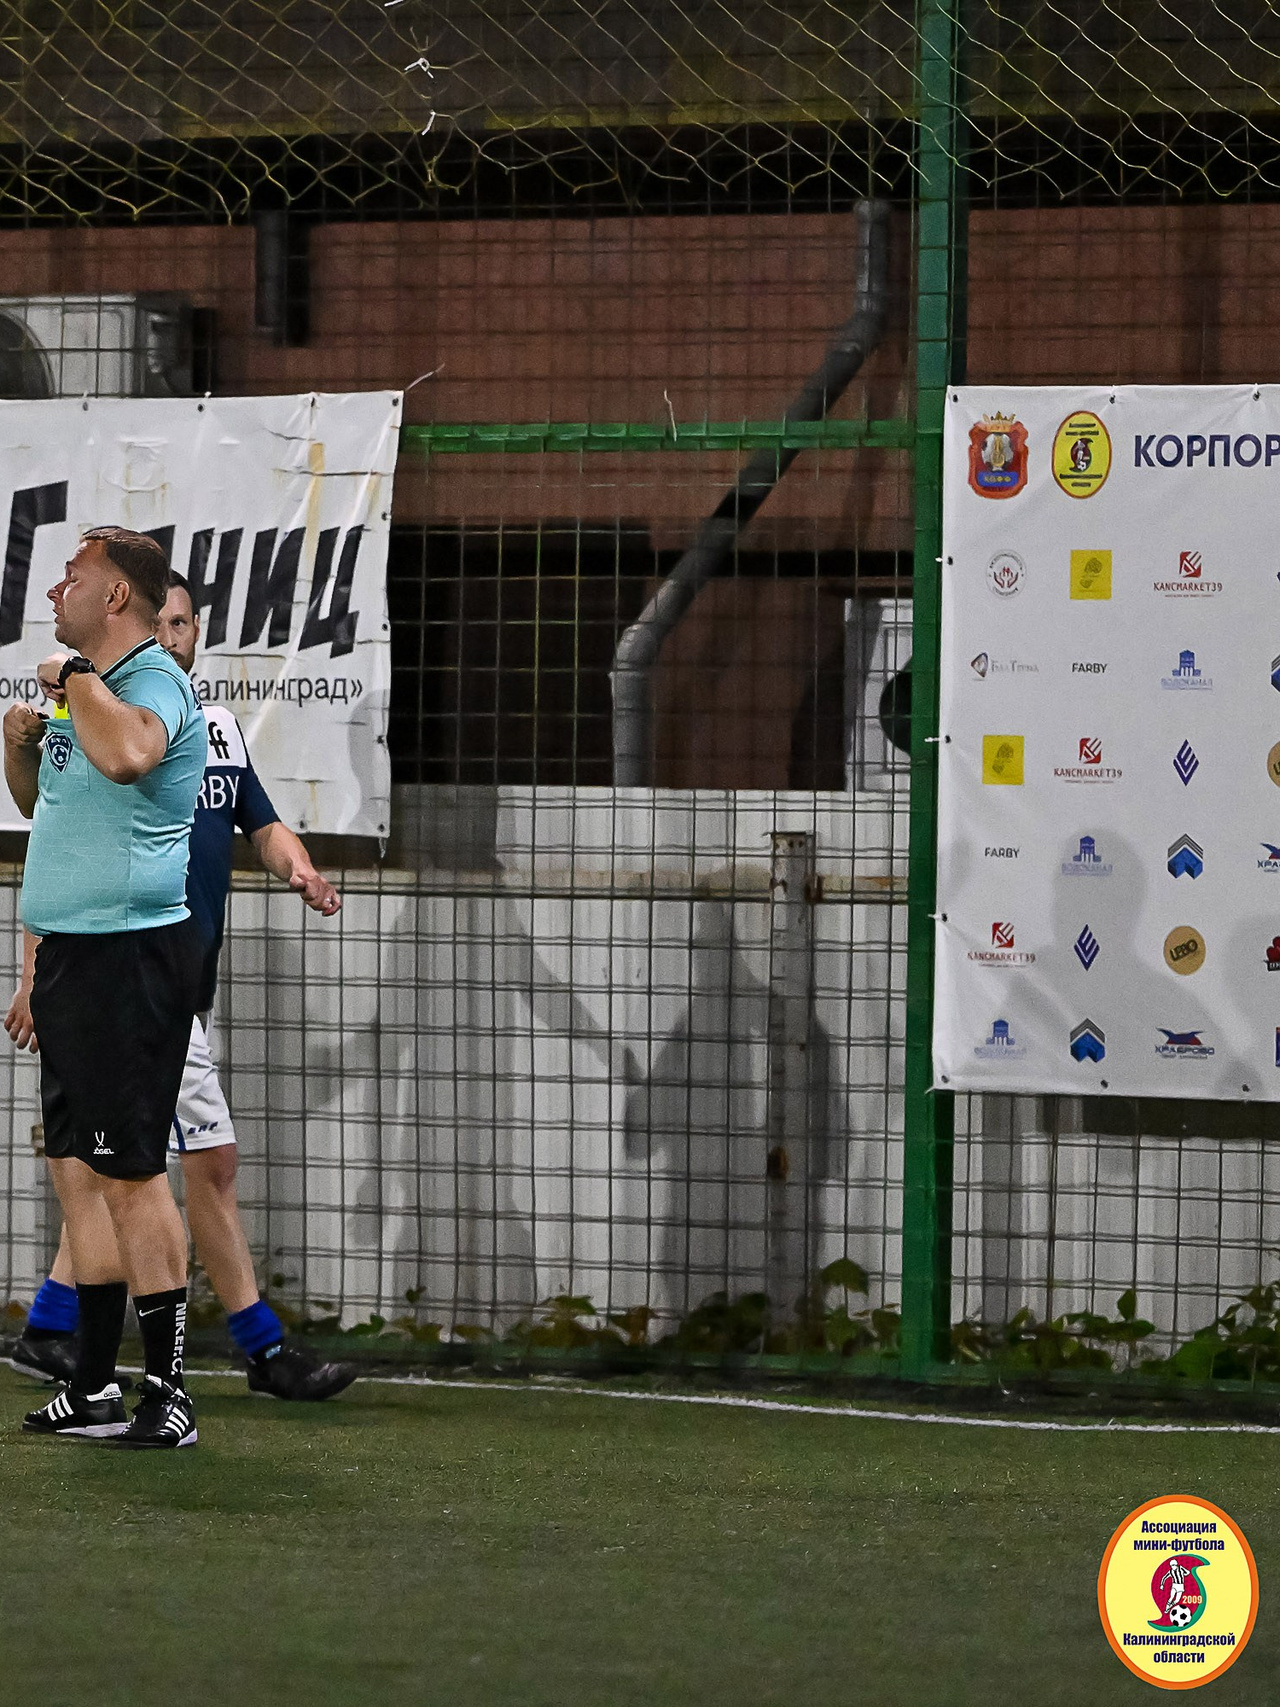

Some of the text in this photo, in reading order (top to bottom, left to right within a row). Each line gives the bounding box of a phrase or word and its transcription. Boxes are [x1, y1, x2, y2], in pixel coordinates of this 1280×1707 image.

[1134, 433, 1280, 468] КОРПОР
[1153, 581, 1223, 593] KANCMARKET39
[1071, 662, 1108, 674] FARBY
[1053, 767, 1123, 779] KANCMARKET39
[984, 847, 1020, 858] FARBY
